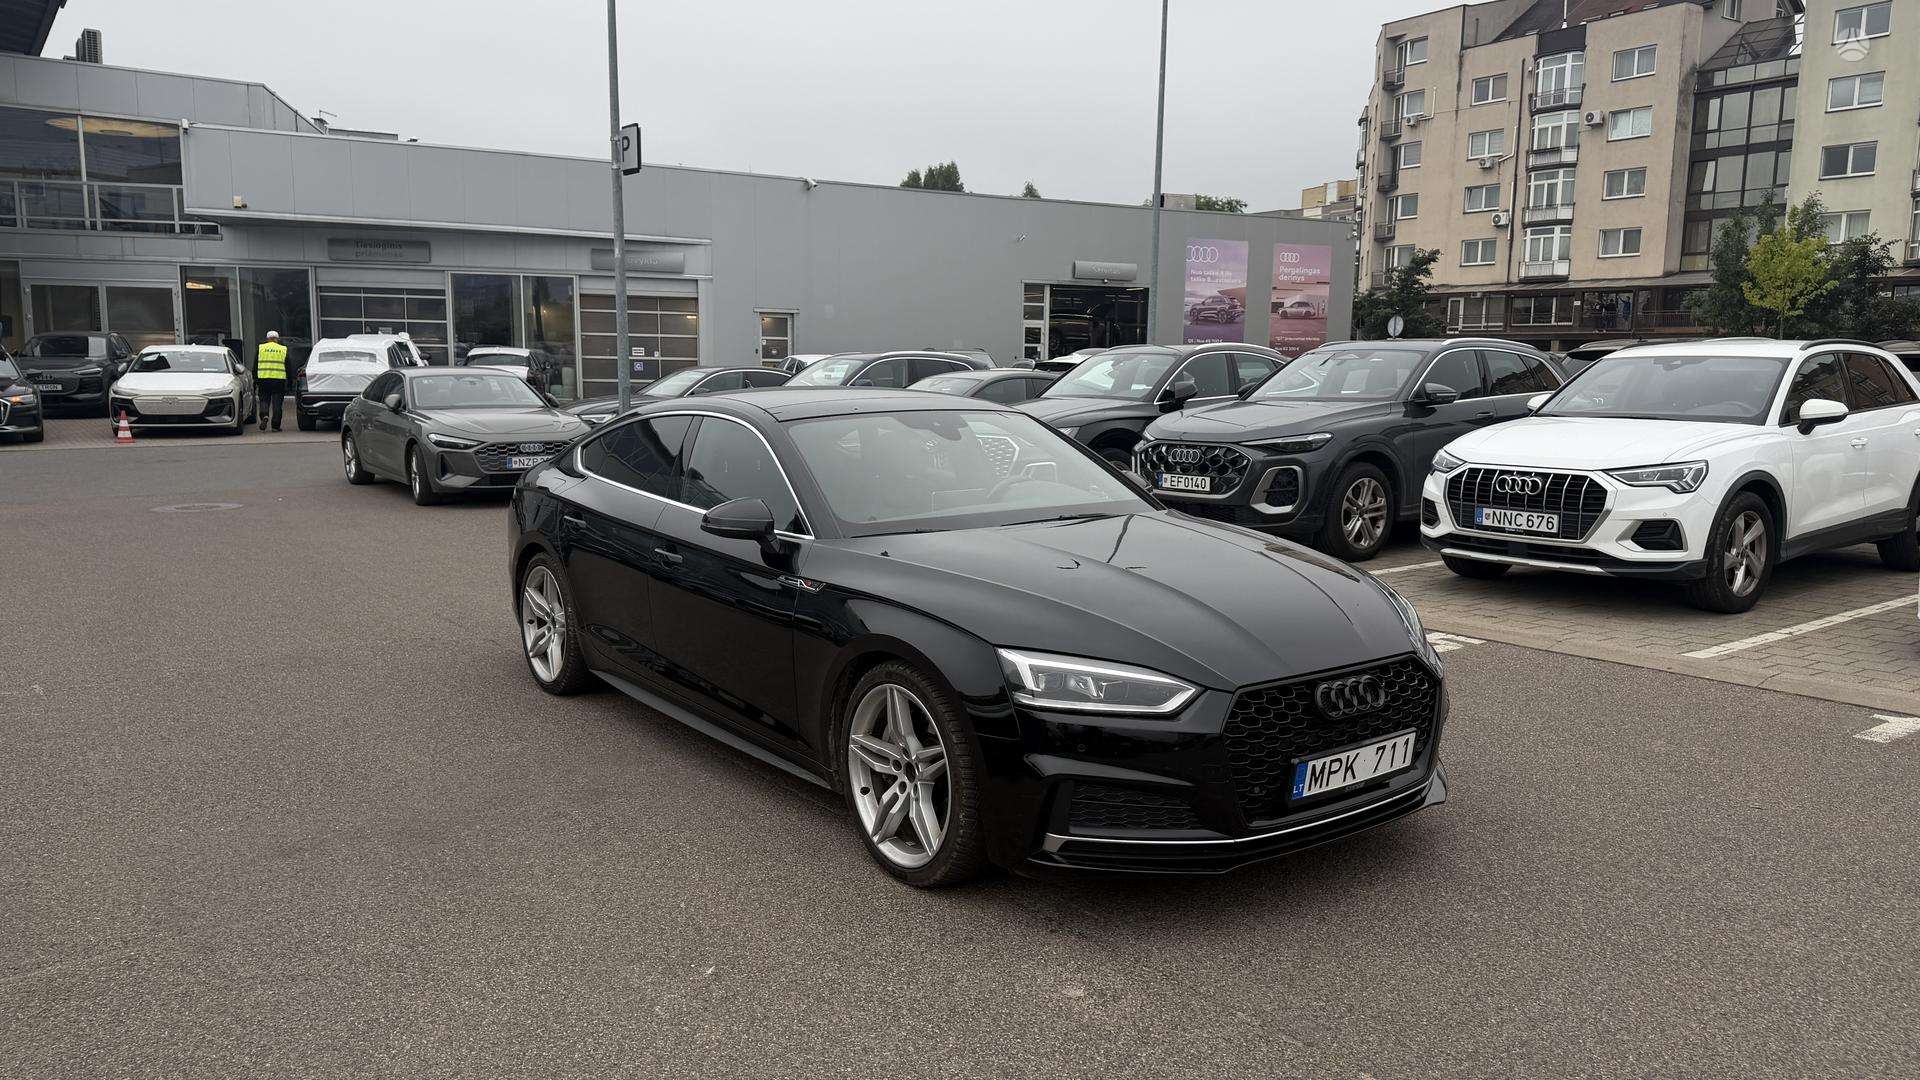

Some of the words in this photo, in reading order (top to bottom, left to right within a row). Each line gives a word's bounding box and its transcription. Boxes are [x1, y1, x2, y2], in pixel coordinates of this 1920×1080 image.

[621, 135, 630, 162] P
[1279, 265, 1320, 276] Pergalingas
[1279, 275, 1304, 283] derinys
[518, 457, 539, 467] NZP
[1170, 475, 1207, 489] EF0140
[1491, 510, 1523, 527] NNC
[1526, 514, 1555, 531] 676
[1308, 752, 1360, 792] MPK
[1372, 737, 1410, 774] 711
[1293, 783, 1304, 793] LT
